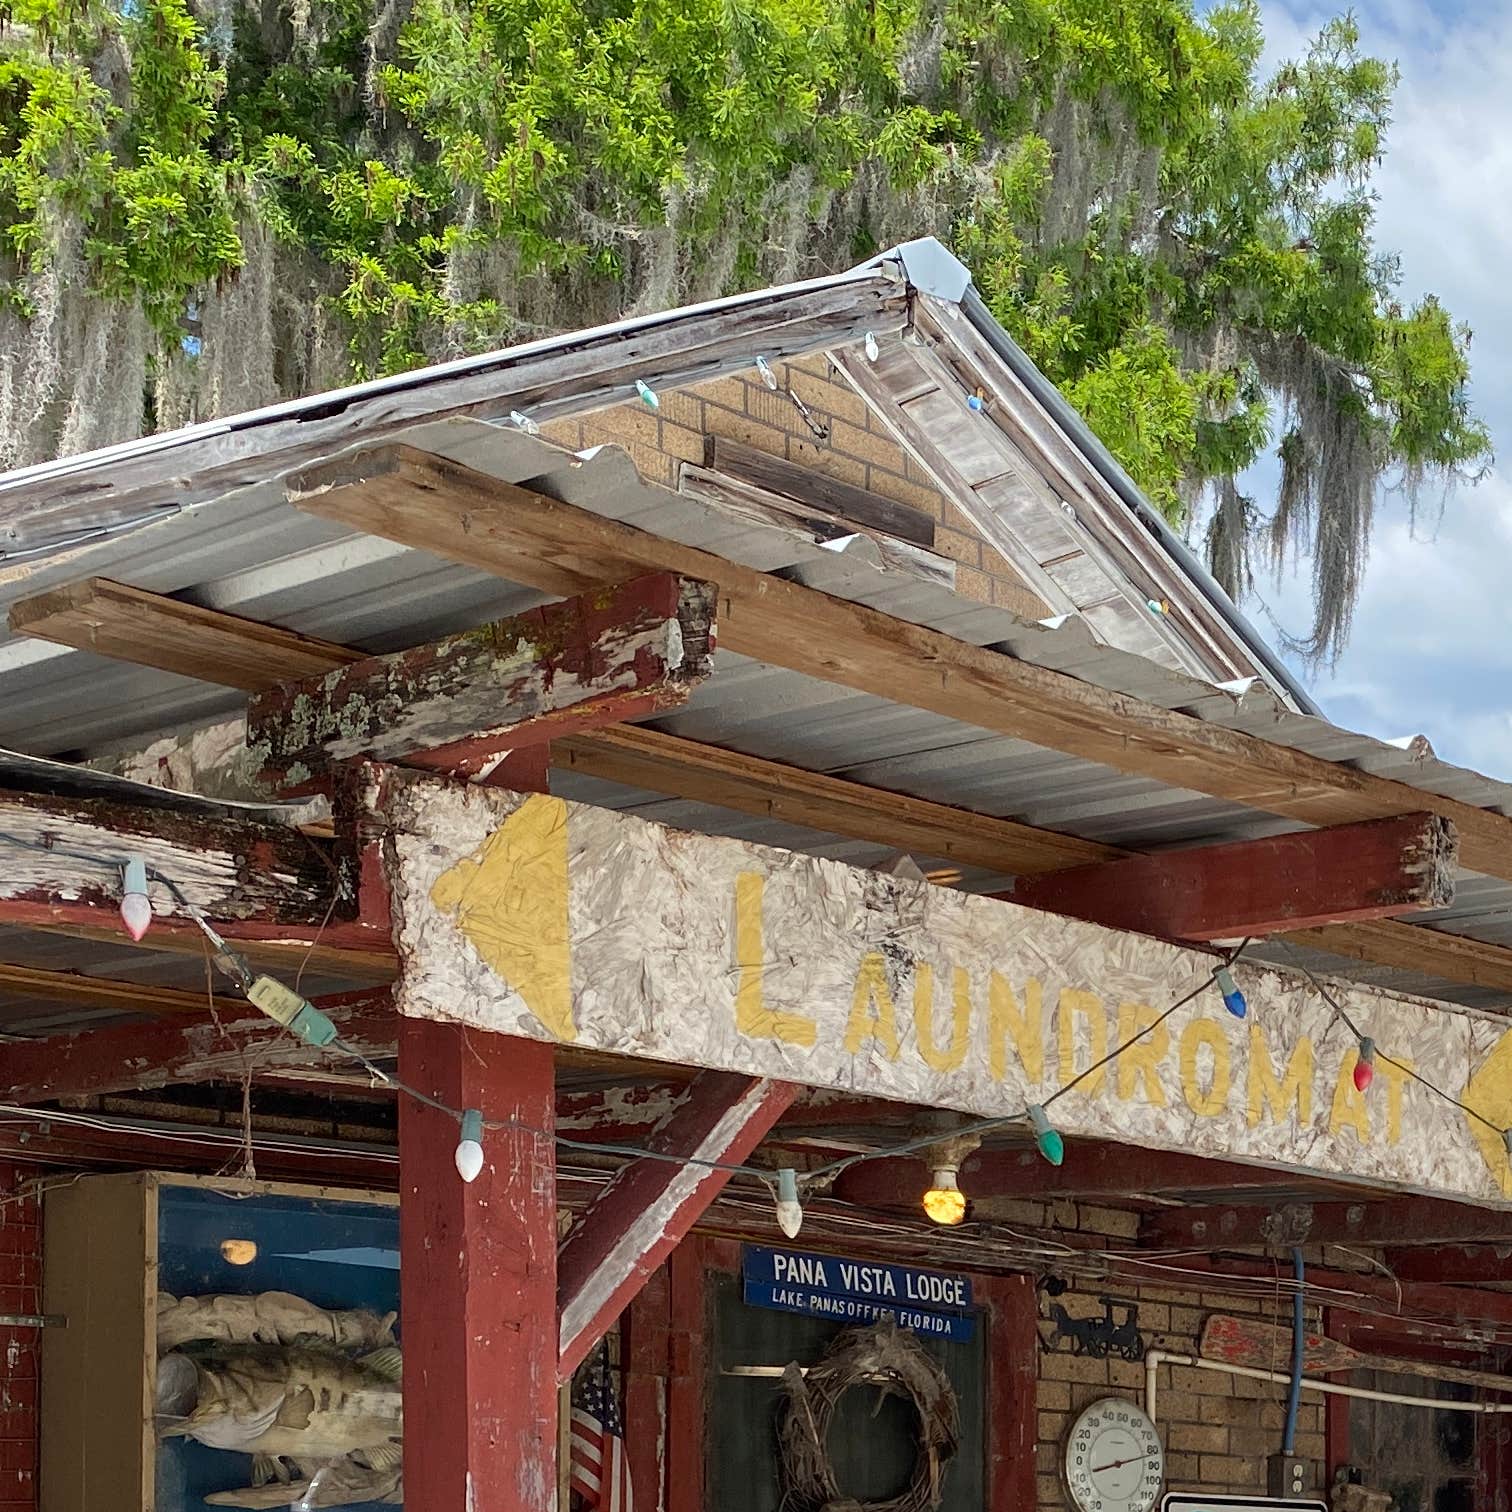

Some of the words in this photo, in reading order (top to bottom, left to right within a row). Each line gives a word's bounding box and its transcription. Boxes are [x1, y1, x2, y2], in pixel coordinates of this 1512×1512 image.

[736, 870, 1411, 1147] LAUNDROMAT
[773, 1253, 828, 1288] PANA
[839, 1263, 897, 1297] VISTA
[905, 1272, 967, 1306] LODGE
[772, 1288, 804, 1307] LAKE
[899, 1311, 952, 1334] FLORIDA
[1102, 1411, 1114, 1421] 40
[1117, 1412, 1128, 1422] 50
[1087, 1417, 1100, 1428] 30
[1130, 1418, 1142, 1428] 60
[1078, 1429, 1091, 1439] 20
[1141, 1430, 1153, 1440] 70
[1076, 1442, 1087, 1452] 10
[1146, 1445, 1159, 1455] 80
[1148, 1461, 1160, 1471] 90
[1145, 1475, 1161, 1486] 100
[1140, 1491, 1154, 1501] 110
[1089, 1500, 1102, 1511] 30
[1127, 1503, 1143, 1512] 120
